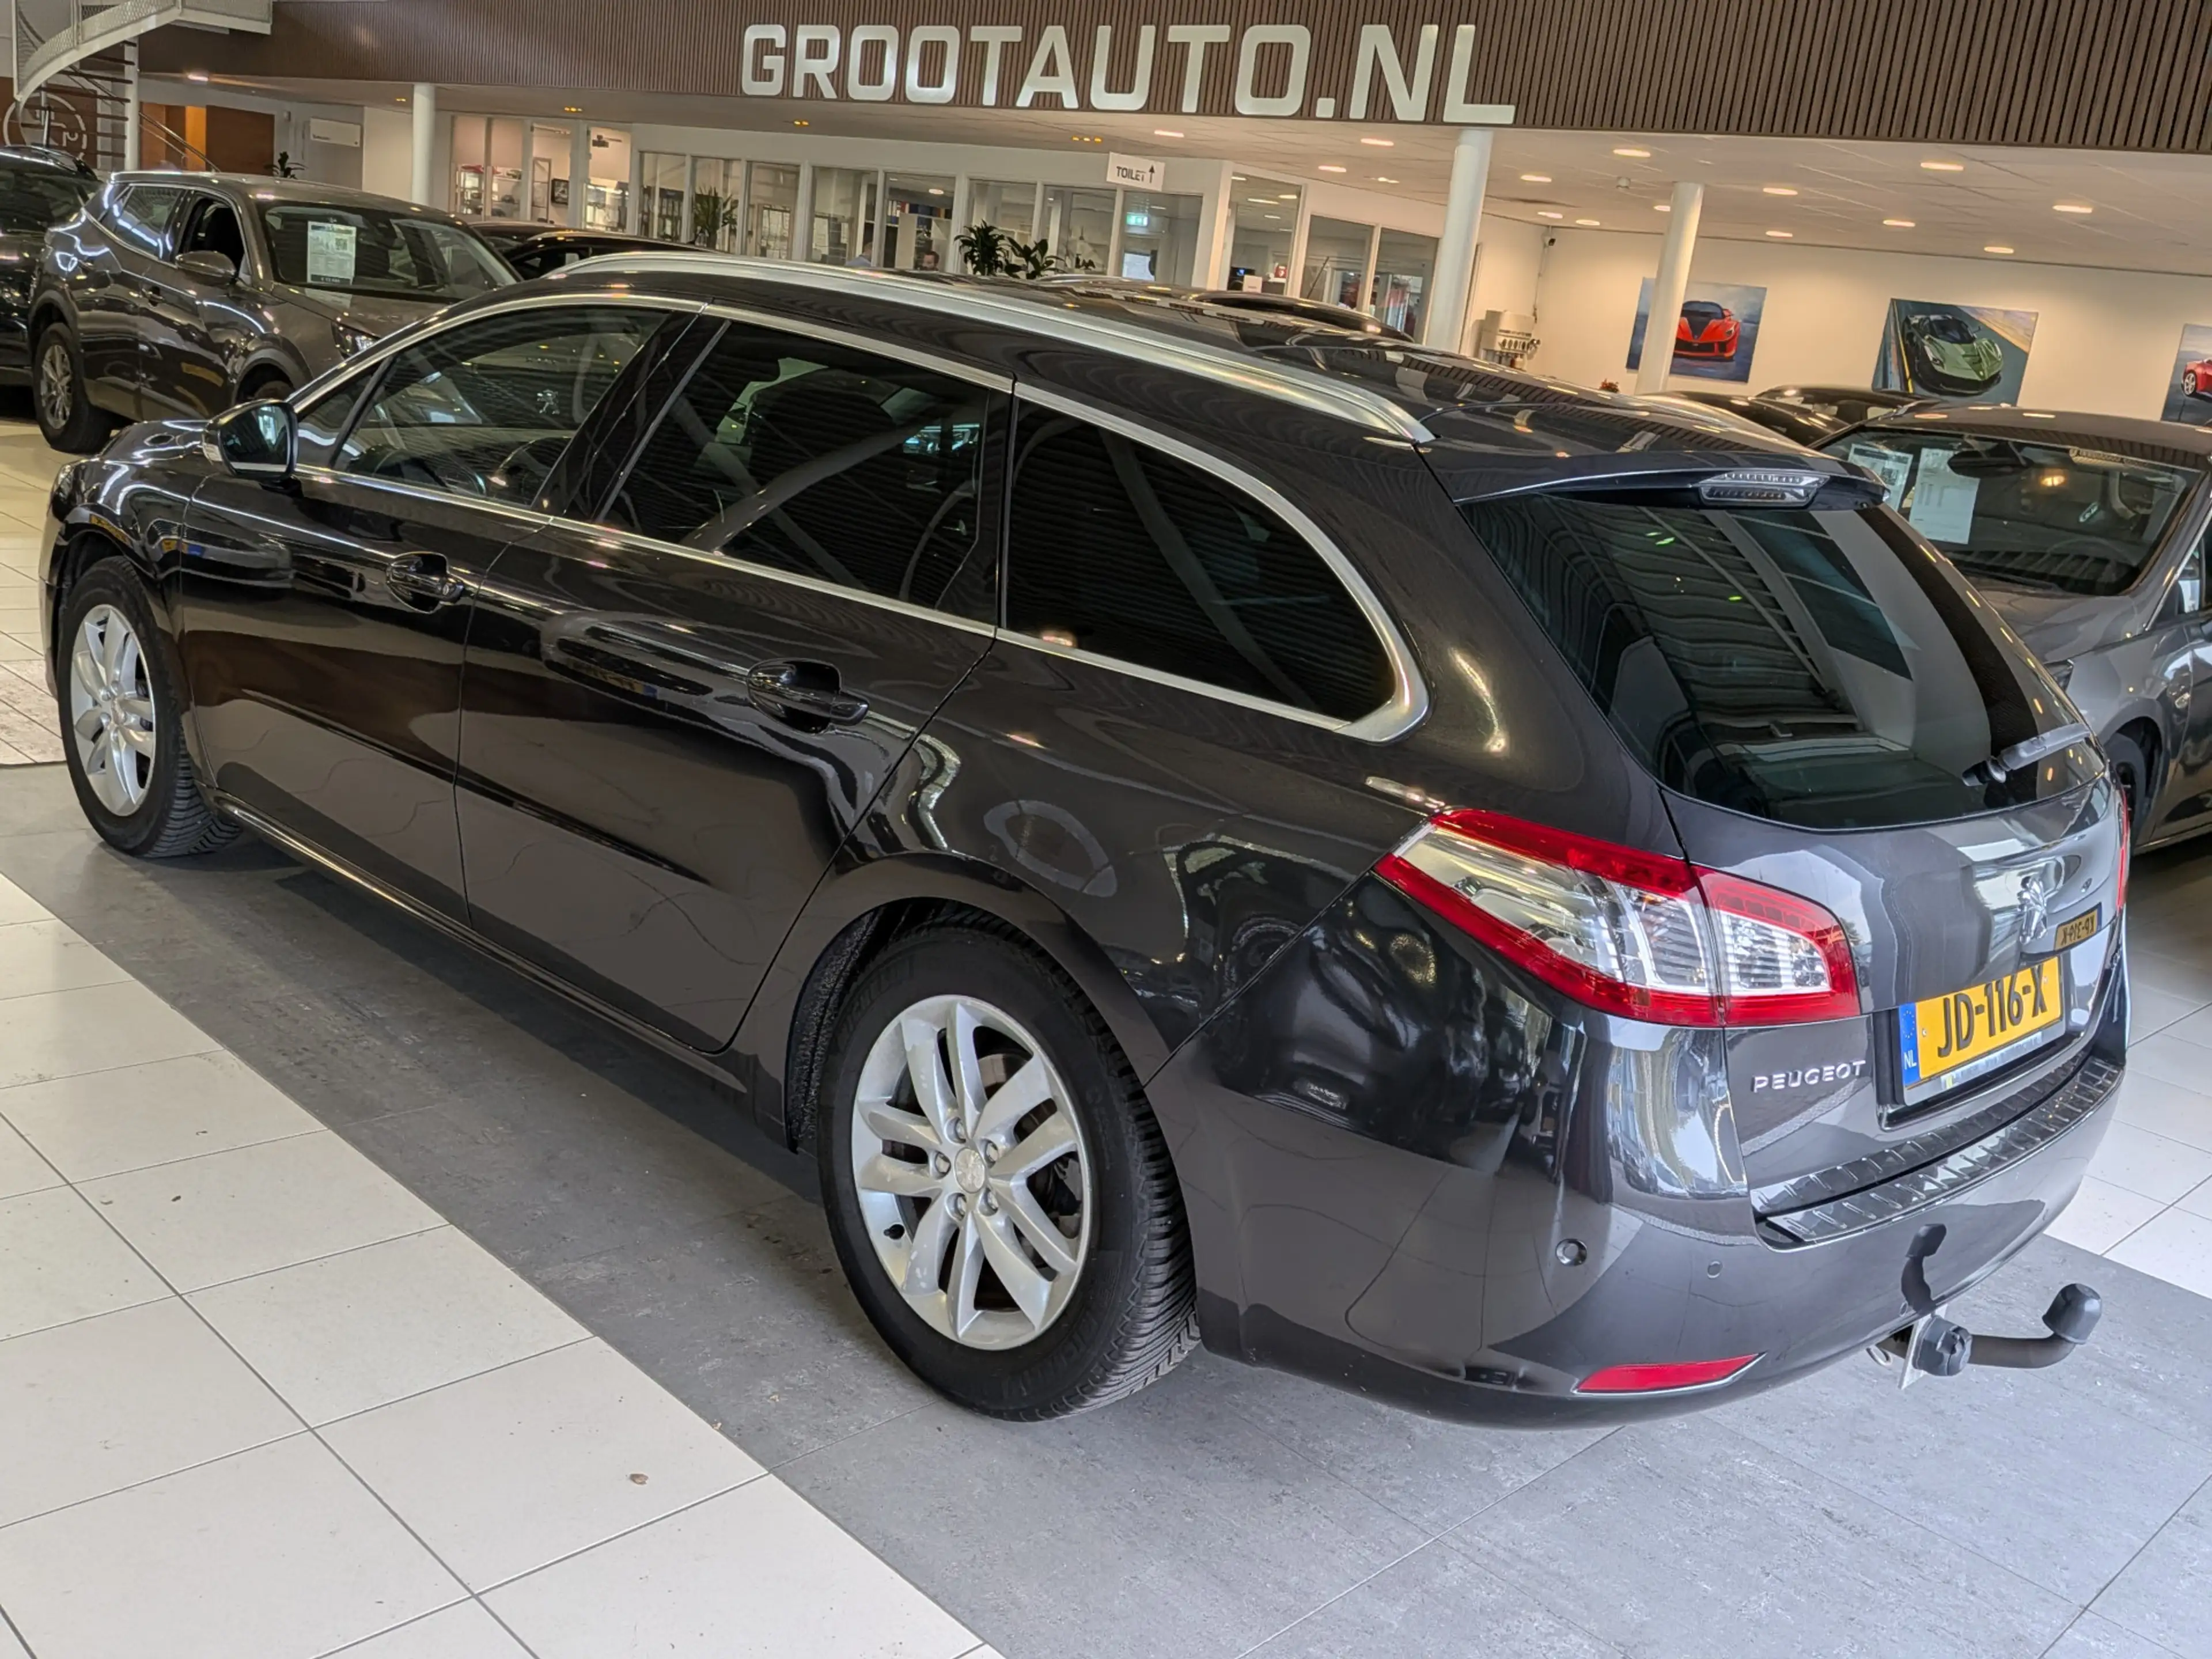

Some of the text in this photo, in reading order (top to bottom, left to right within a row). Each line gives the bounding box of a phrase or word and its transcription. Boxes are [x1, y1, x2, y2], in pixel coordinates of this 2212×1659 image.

[741, 24, 1516, 124] GROOTAUTO.NL
[1116, 166, 1146, 182] TOILET
[1937, 963, 2048, 1058] JD-116-X
[1903, 1049, 1918, 1070] NL
[1752, 1060, 1866, 1093] PEUGEOT
